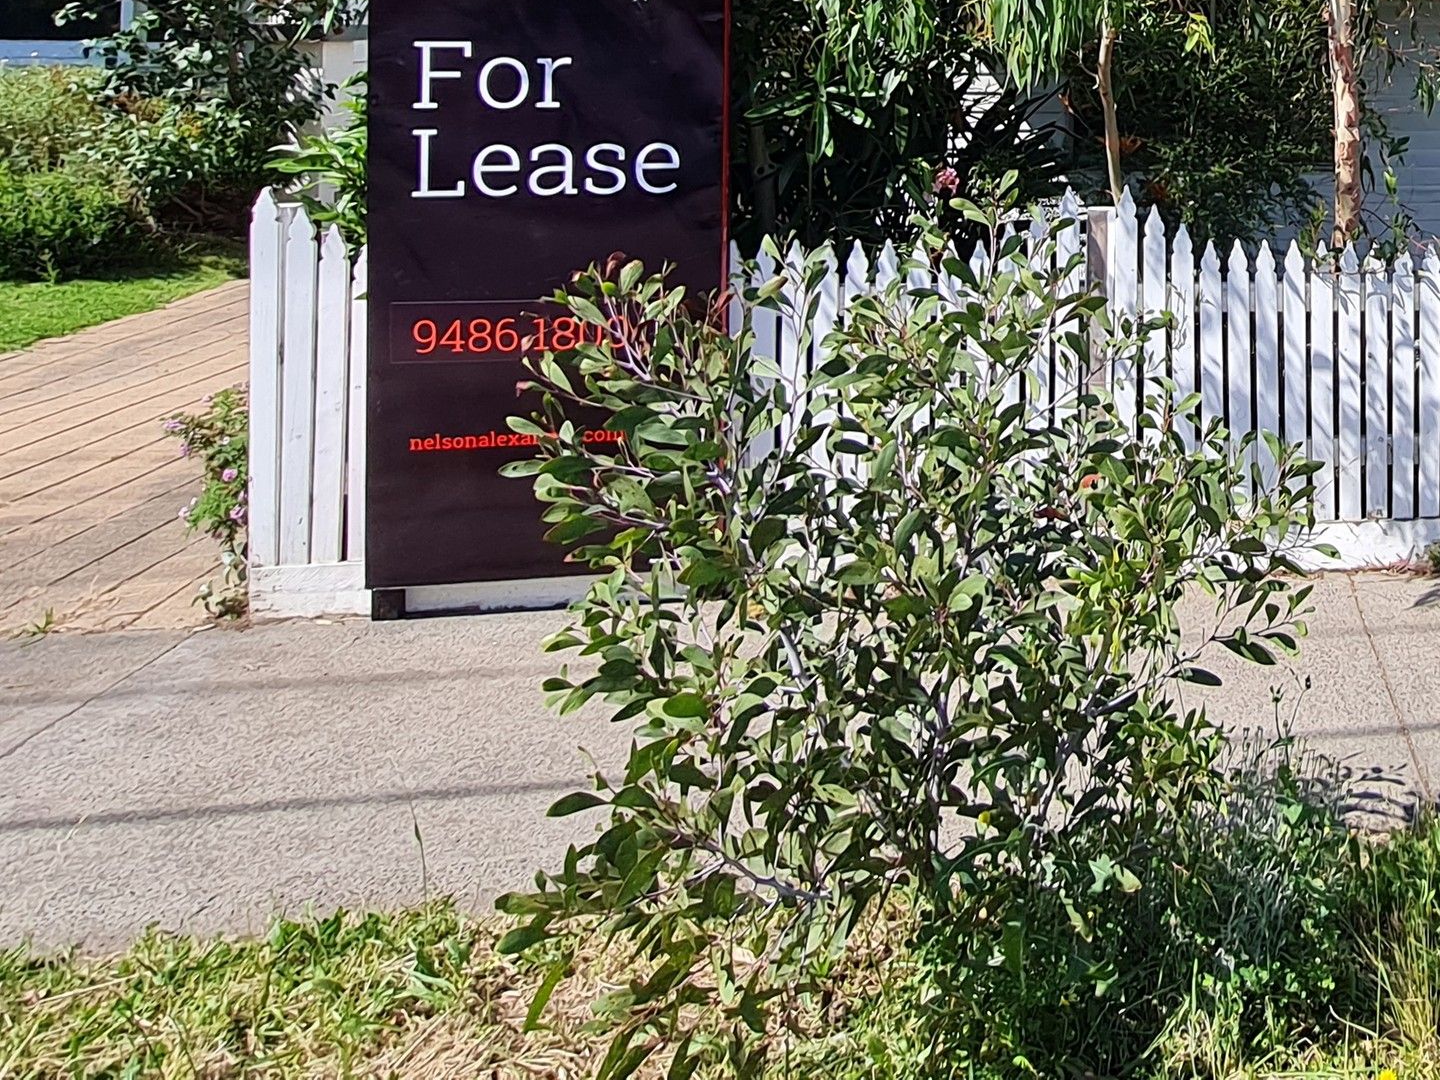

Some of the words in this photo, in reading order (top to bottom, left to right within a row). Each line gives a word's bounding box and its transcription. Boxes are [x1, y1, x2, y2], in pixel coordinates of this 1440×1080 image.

[412, 39, 573, 109] For
[410, 127, 681, 198] Lease
[412, 318, 519, 354] 9486
